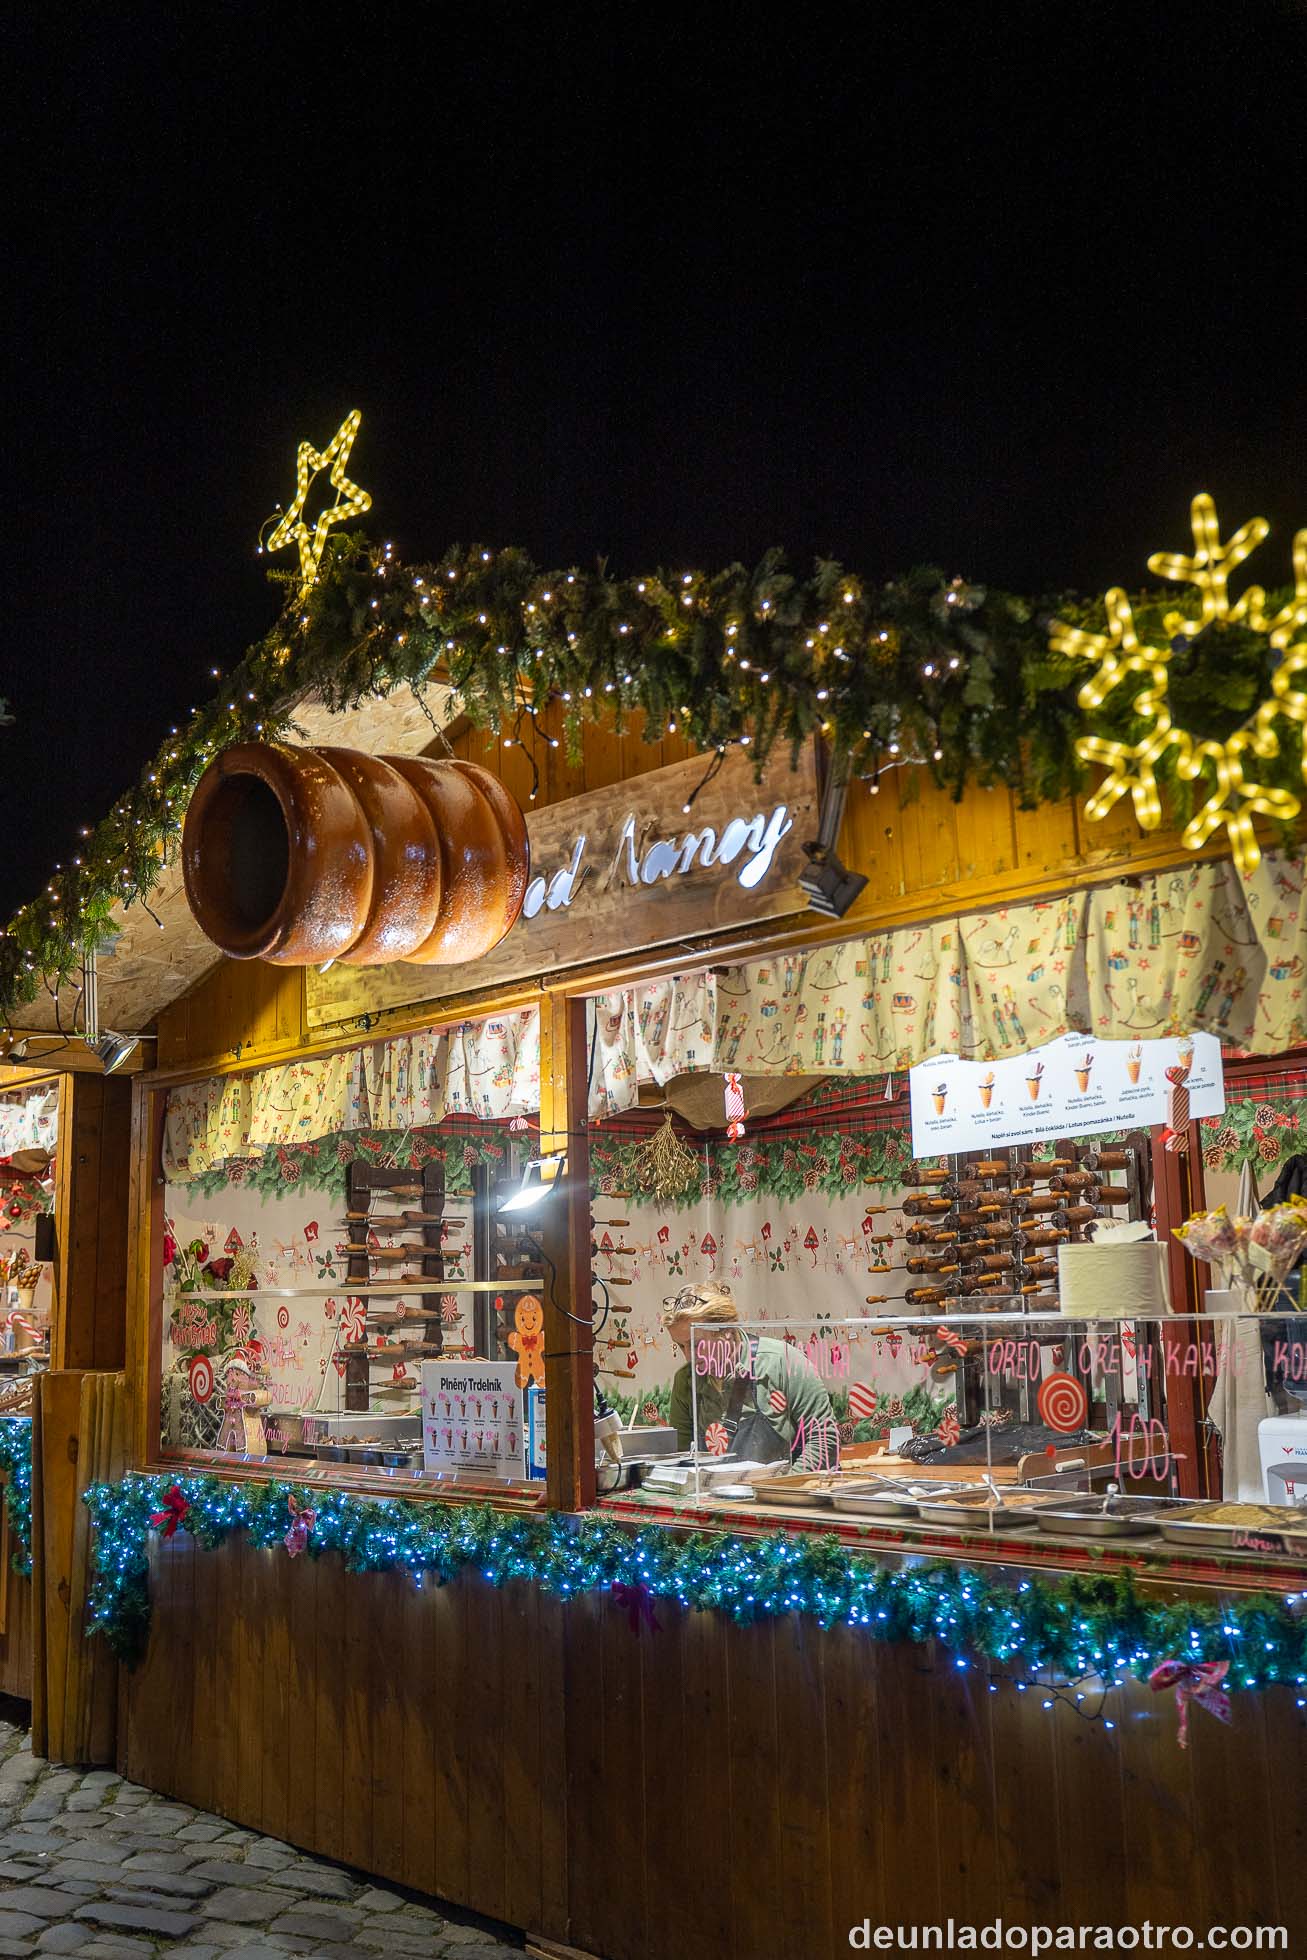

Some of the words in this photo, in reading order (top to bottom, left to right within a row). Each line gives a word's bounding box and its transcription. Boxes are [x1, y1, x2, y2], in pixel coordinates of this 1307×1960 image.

[989, 1341, 1041, 1381] OREO
[1166, 1340, 1247, 1377] KAKAO
[440, 1377, 468, 1393] Plněný
[468, 1378, 502, 1392] Trdelník
